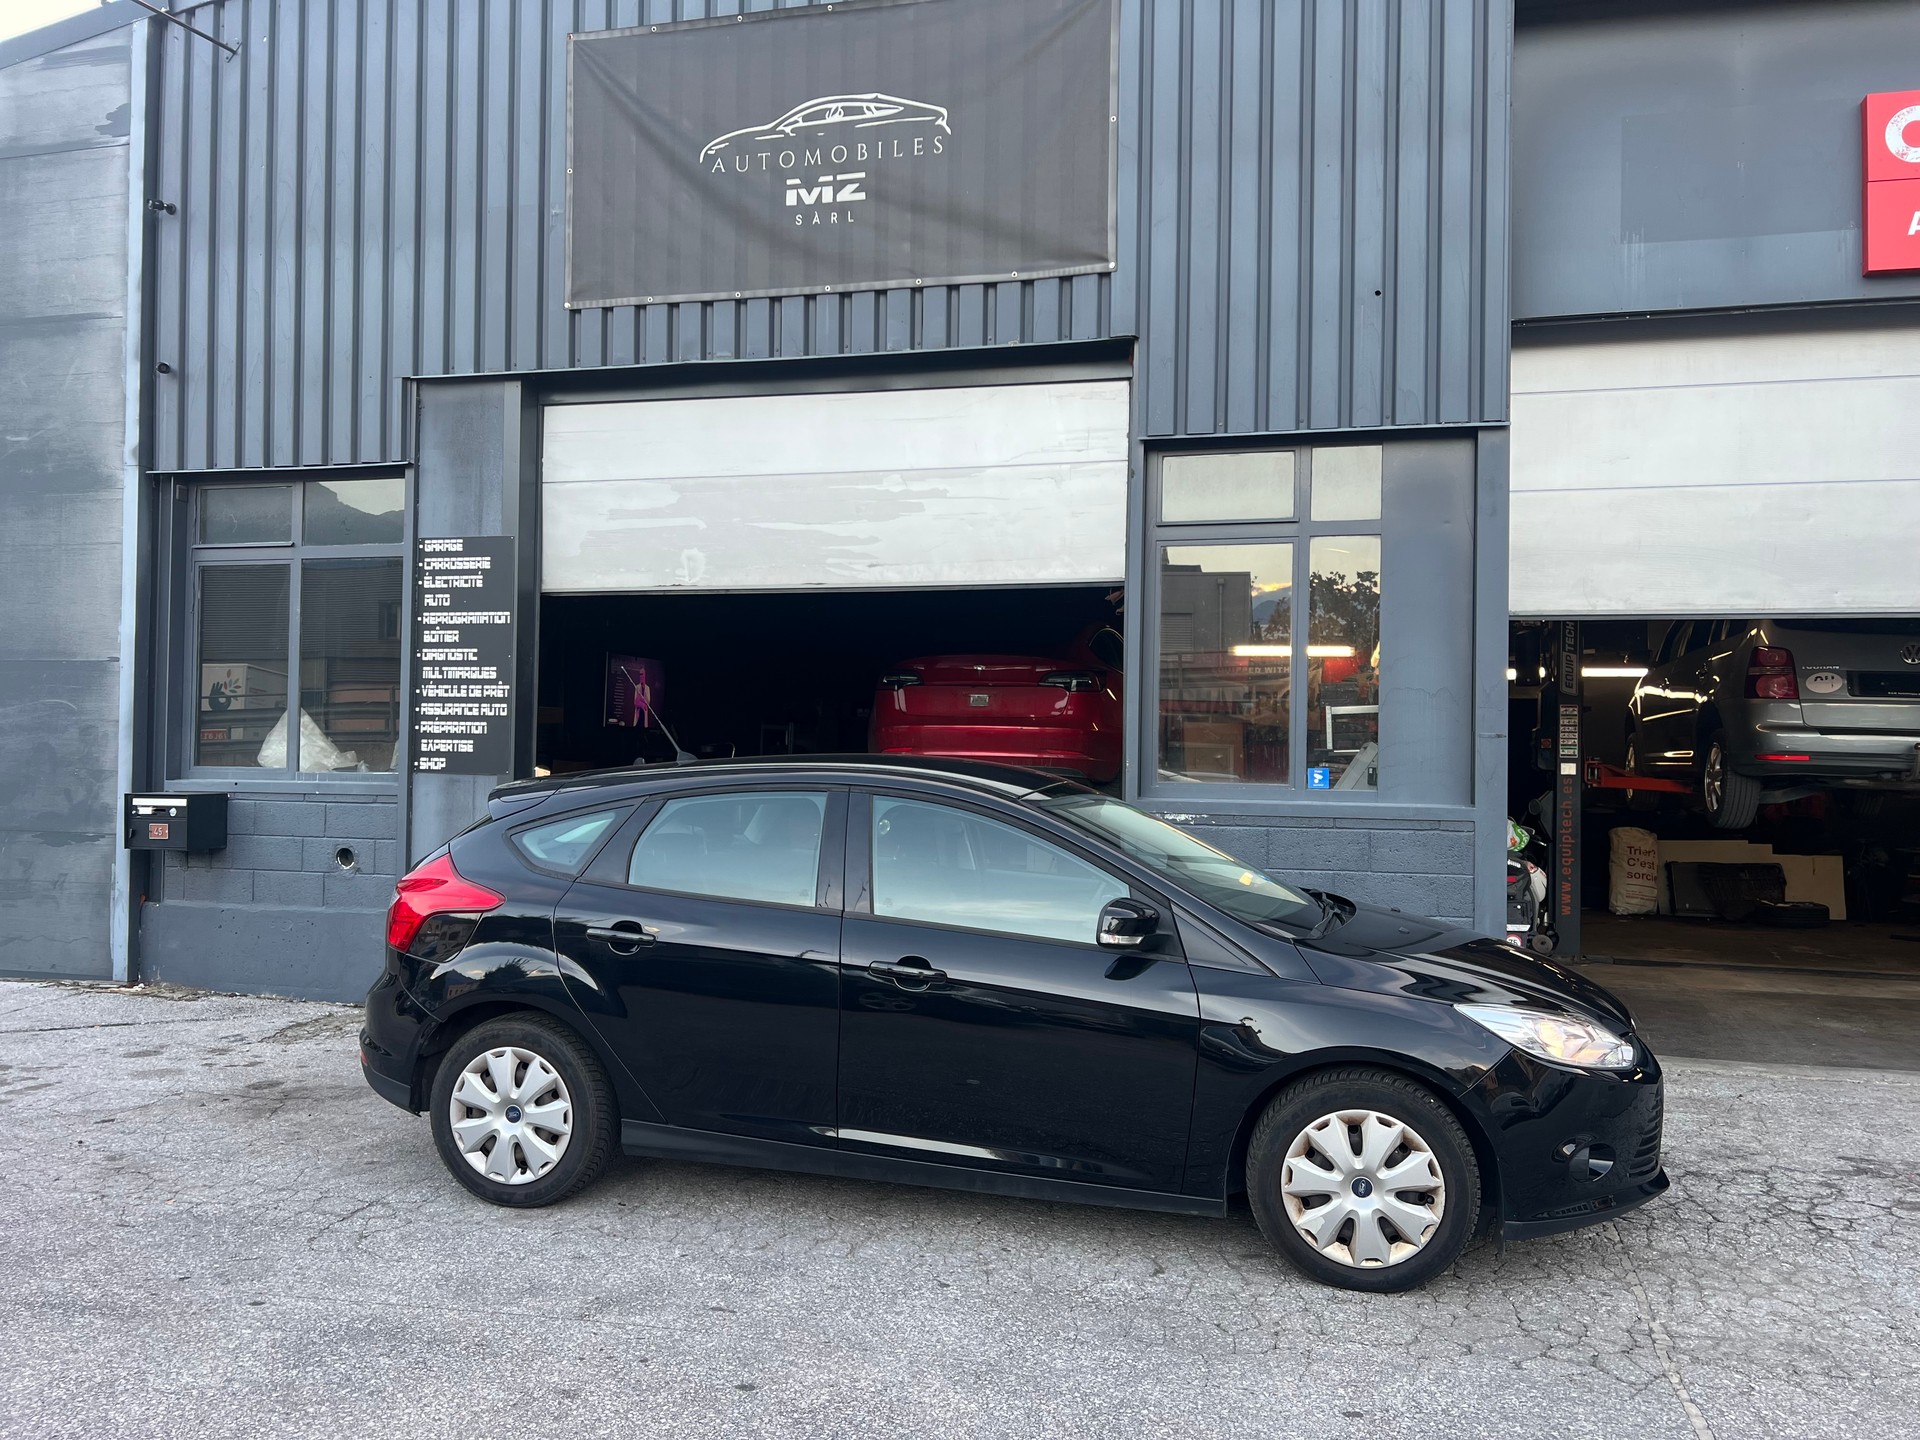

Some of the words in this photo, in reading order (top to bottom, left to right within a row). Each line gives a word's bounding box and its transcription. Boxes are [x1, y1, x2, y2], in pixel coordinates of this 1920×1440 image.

[711, 136, 944, 173] AUTOMOBILES
[785, 171, 867, 207] MZ
[424, 539, 463, 552] GARAGE
[424, 556, 491, 570] CARROSSERIE
[423, 571, 484, 588] ÉLECTRICITÉ
[424, 594, 451, 606] AUTO
[423, 626, 459, 643] BOÎTIER
[1565, 621, 1575, 652] TECH
[422, 648, 478, 661] DIAGNOSTIC
[1264, 666, 1291, 674] WITH
[1565, 654, 1575, 689] EQUIP
[421, 680, 467, 698] VÉHICULE
[468, 685, 482, 697] DE
[483, 680, 510, 698] PRÊT
[420, 703, 479, 716] ASSURANCE
[480, 703, 508, 716] AUTO
[420, 716, 487, 734] PRÉPARATION
[421, 739, 474, 752] EXPERTISE
[419, 757, 446, 770] SHOP
[153, 827, 163, 836] 45
[1560, 777, 1575, 916] www.equiptech.es
[1627, 857, 1655, 870] C'est
